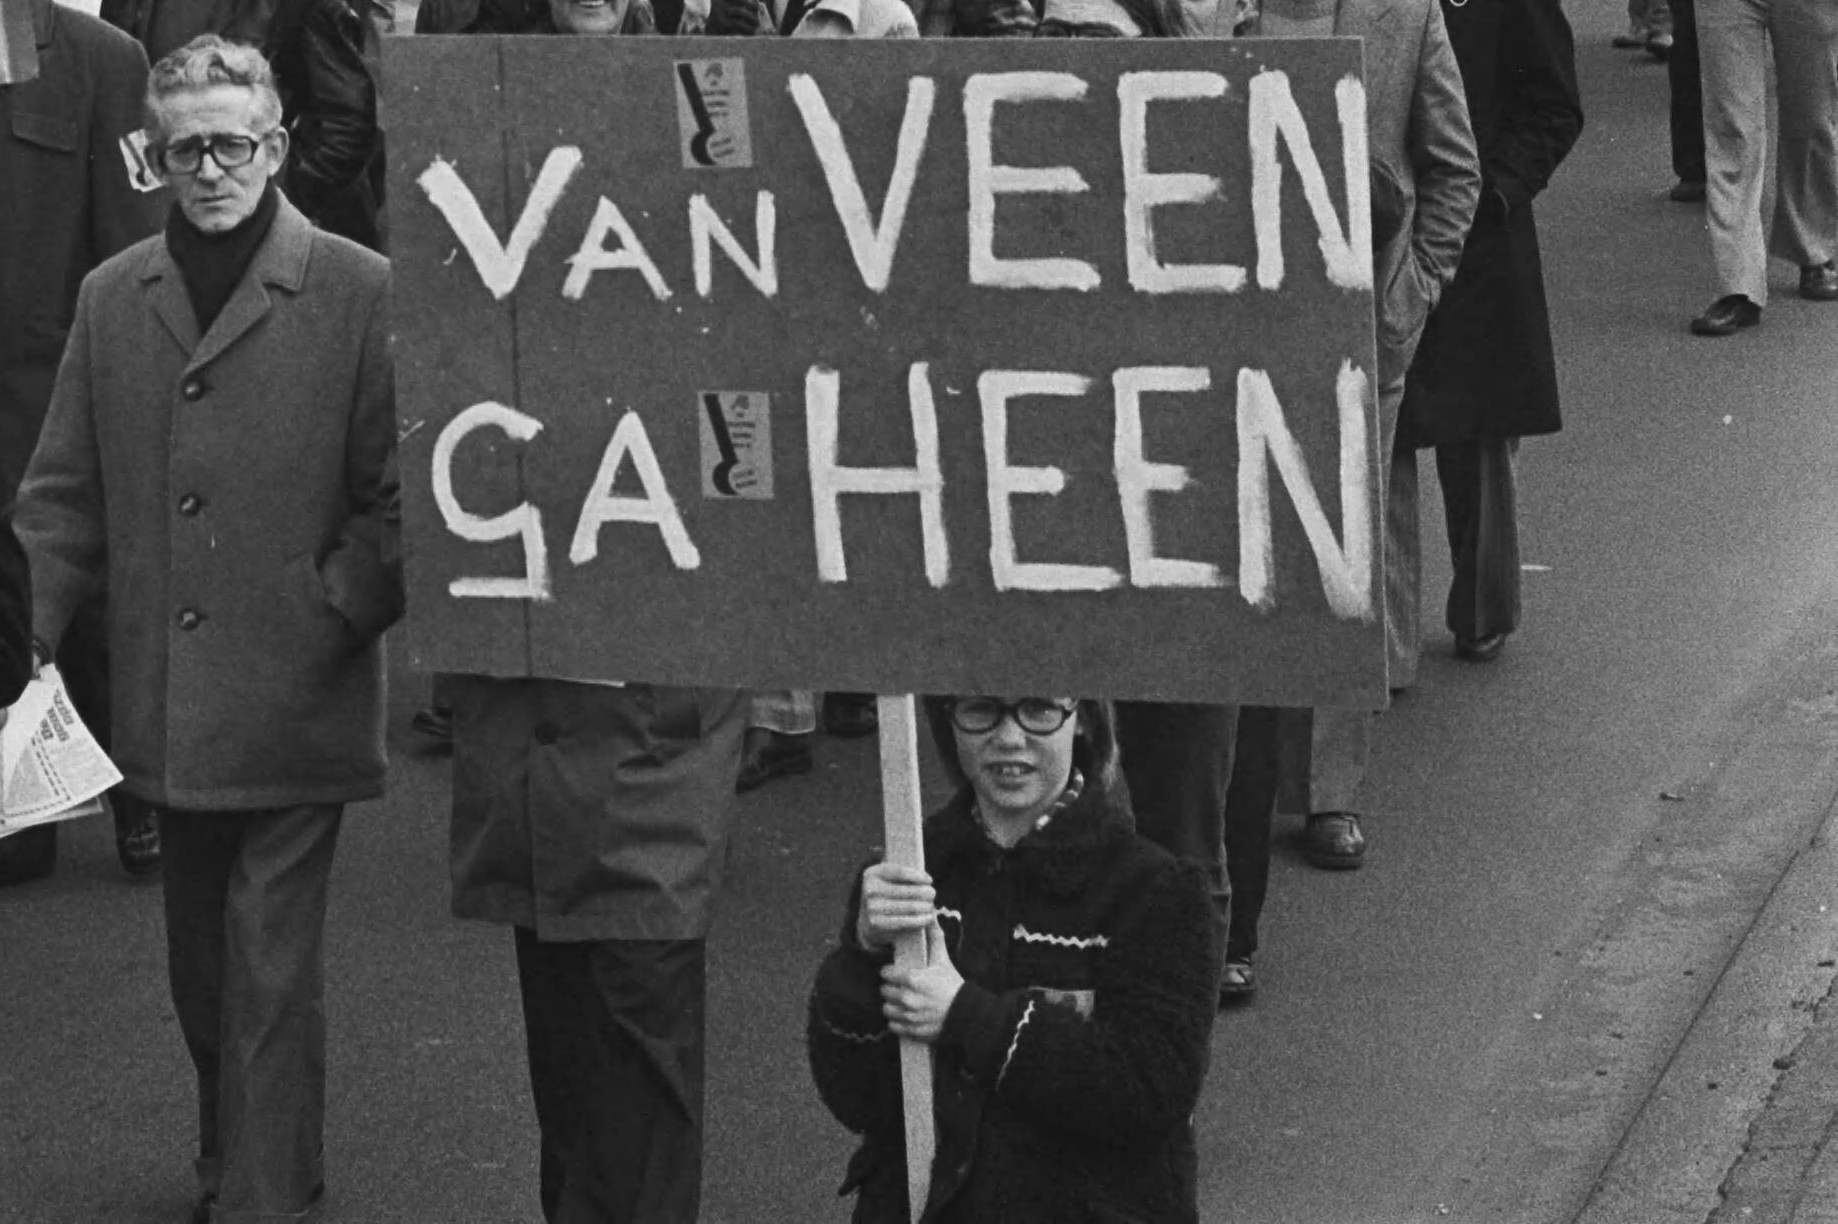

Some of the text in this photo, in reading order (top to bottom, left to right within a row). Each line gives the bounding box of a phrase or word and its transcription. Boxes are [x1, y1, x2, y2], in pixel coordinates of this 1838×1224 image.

[416, 144, 778, 301] VAN
[787, 70, 1372, 293] VEEN
[805, 359, 1374, 620] HEEN
